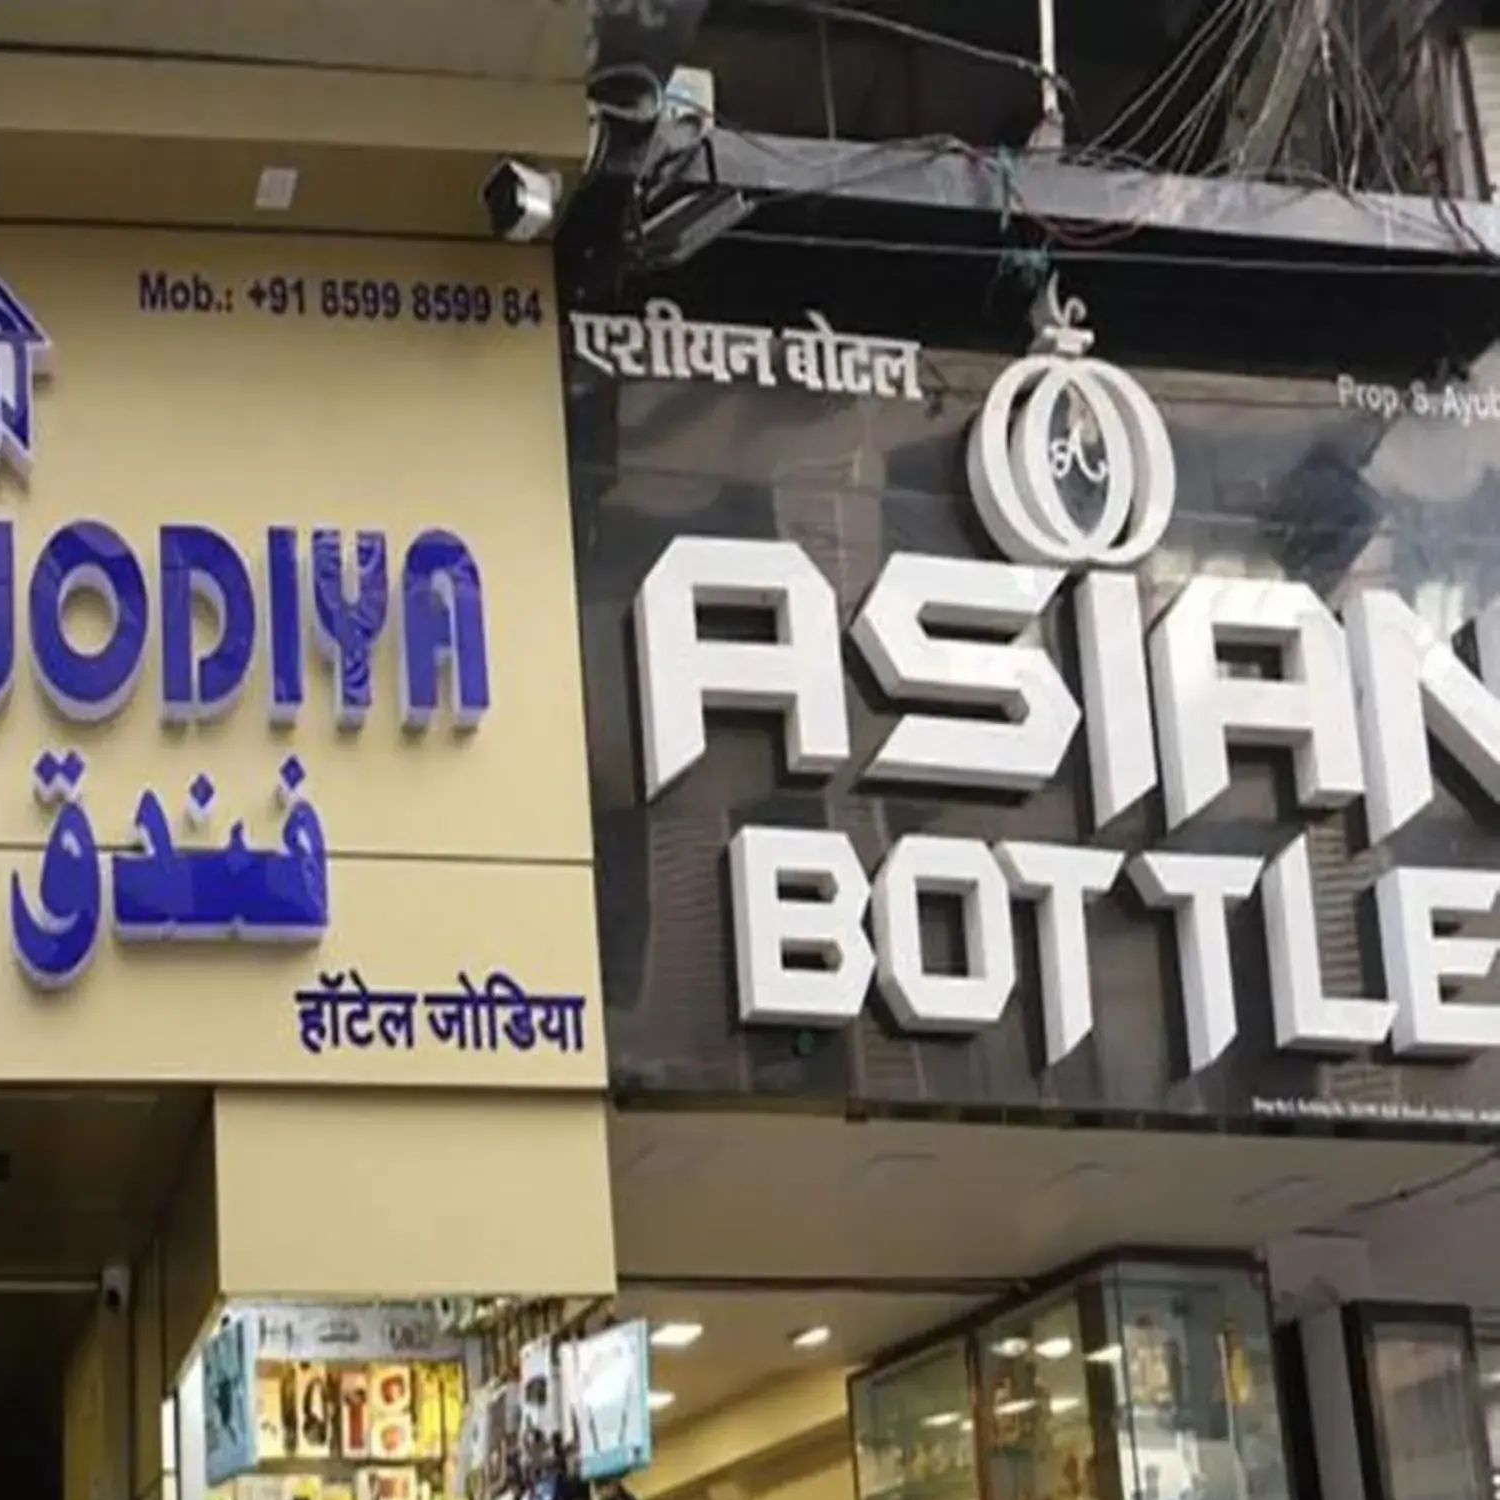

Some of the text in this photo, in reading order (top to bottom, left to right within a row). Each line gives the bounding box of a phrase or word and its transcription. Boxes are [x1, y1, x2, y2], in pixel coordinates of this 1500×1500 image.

[247, 277, 306, 315] +91
[320, 279, 400, 319] 8599
[411, 281, 492, 323] 8599
[502, 287, 542, 325] 84
[782, 309, 923, 400] बोटल
[636, 537, 1500, 846] ASIAN
[11, 748, 329, 988] فندق
[294, 969, 586, 1053] हॉटेल जोडिया
